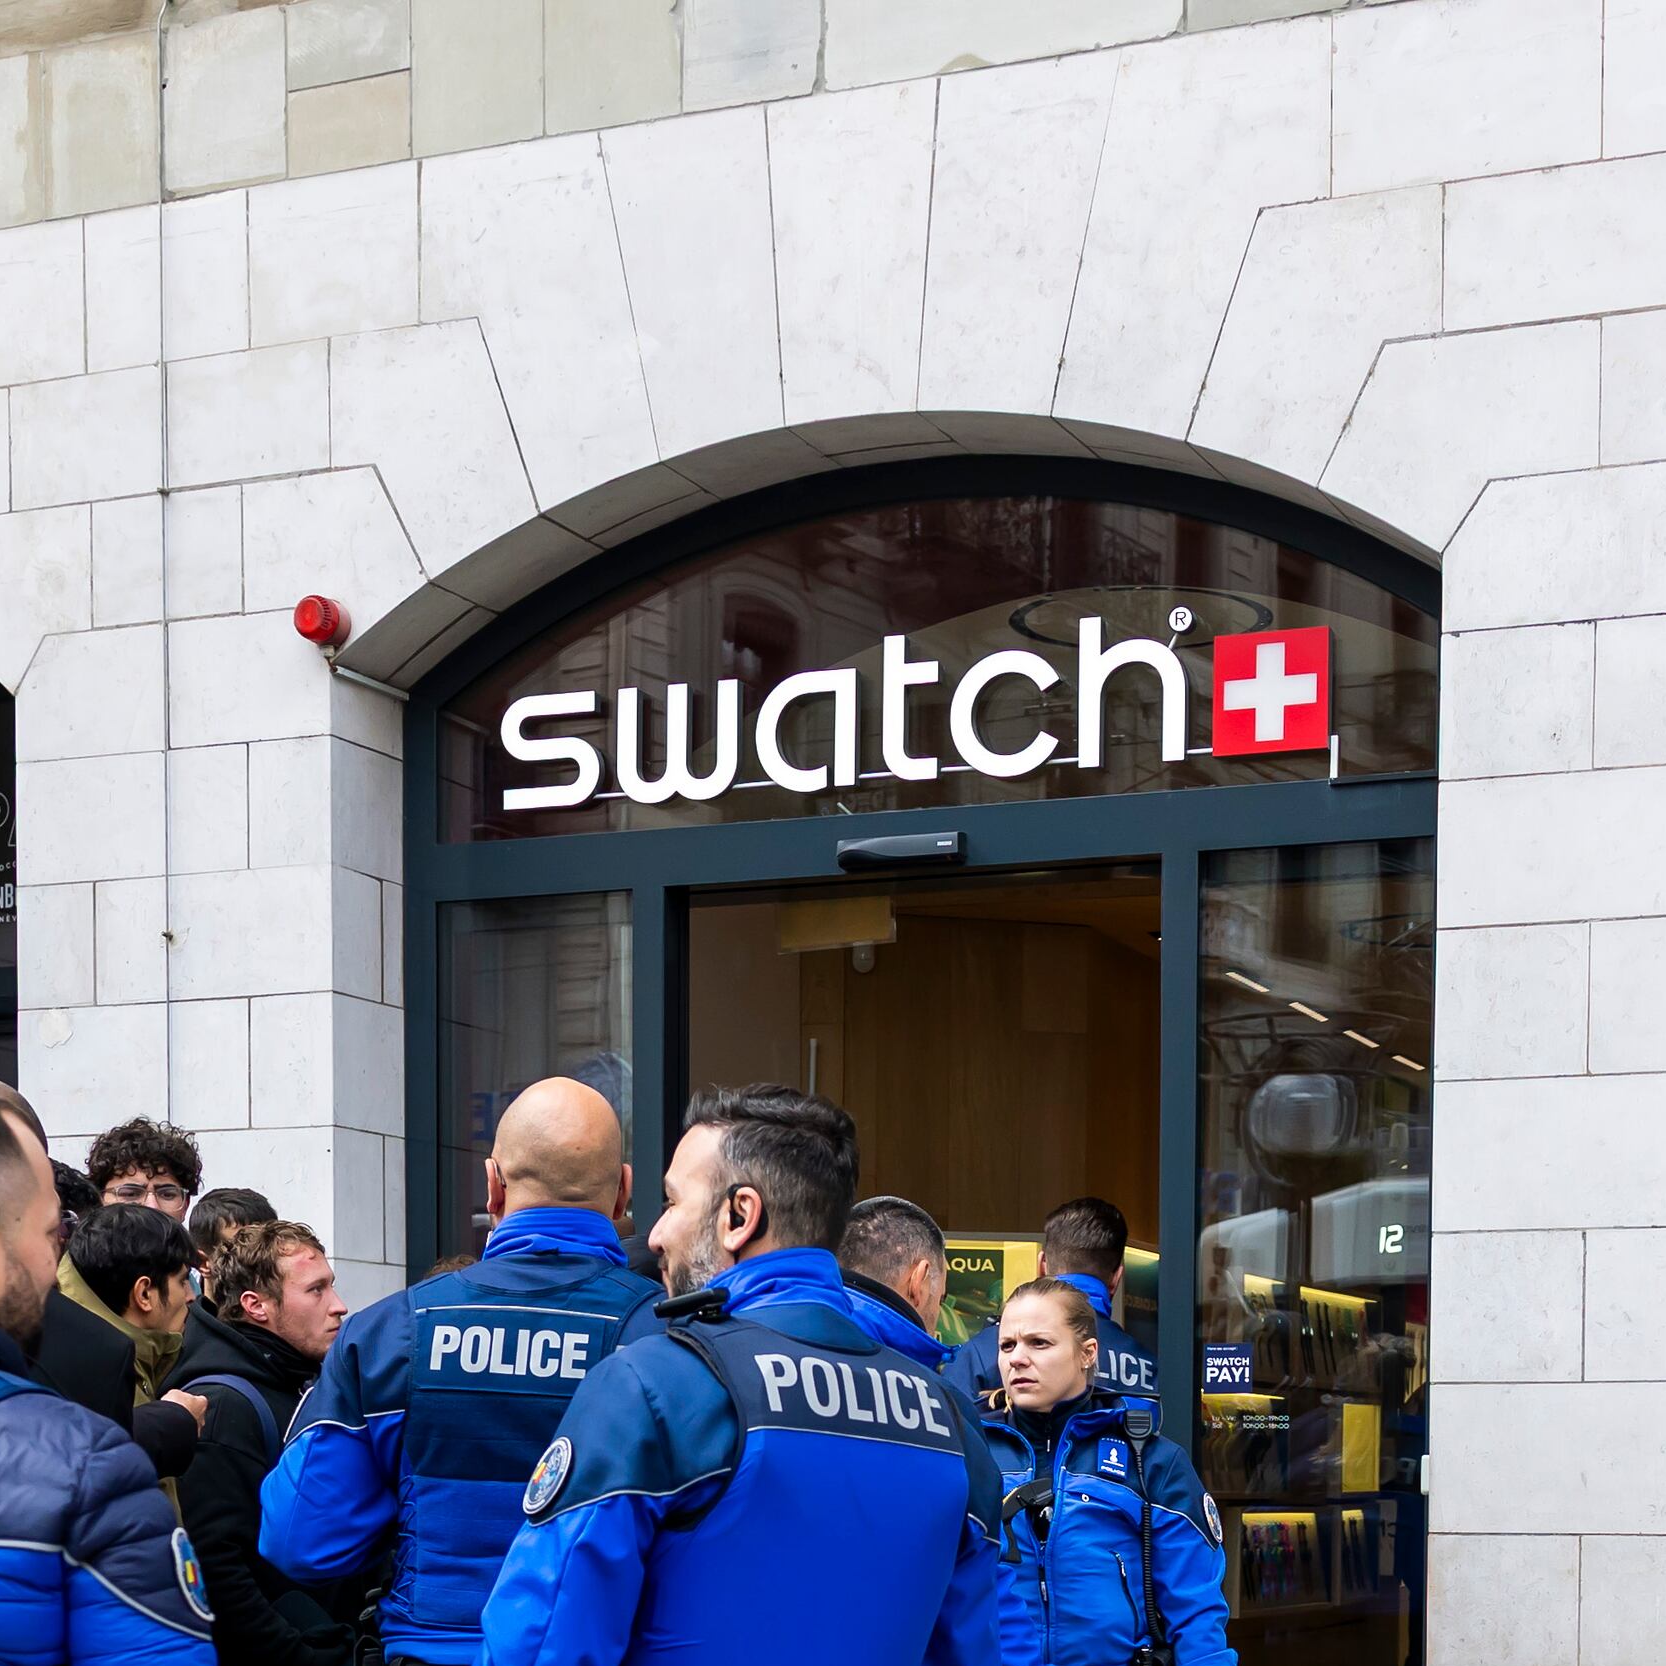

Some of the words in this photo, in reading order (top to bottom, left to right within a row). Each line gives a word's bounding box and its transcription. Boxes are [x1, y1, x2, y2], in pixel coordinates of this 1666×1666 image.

[1378, 1224, 1404, 1254] 12
[429, 1324, 590, 1379] POLICE
[1206, 1357, 1250, 1366] SWATCH
[1206, 1367, 1250, 1383] PAY!
[753, 1352, 951, 1438] POLICE
